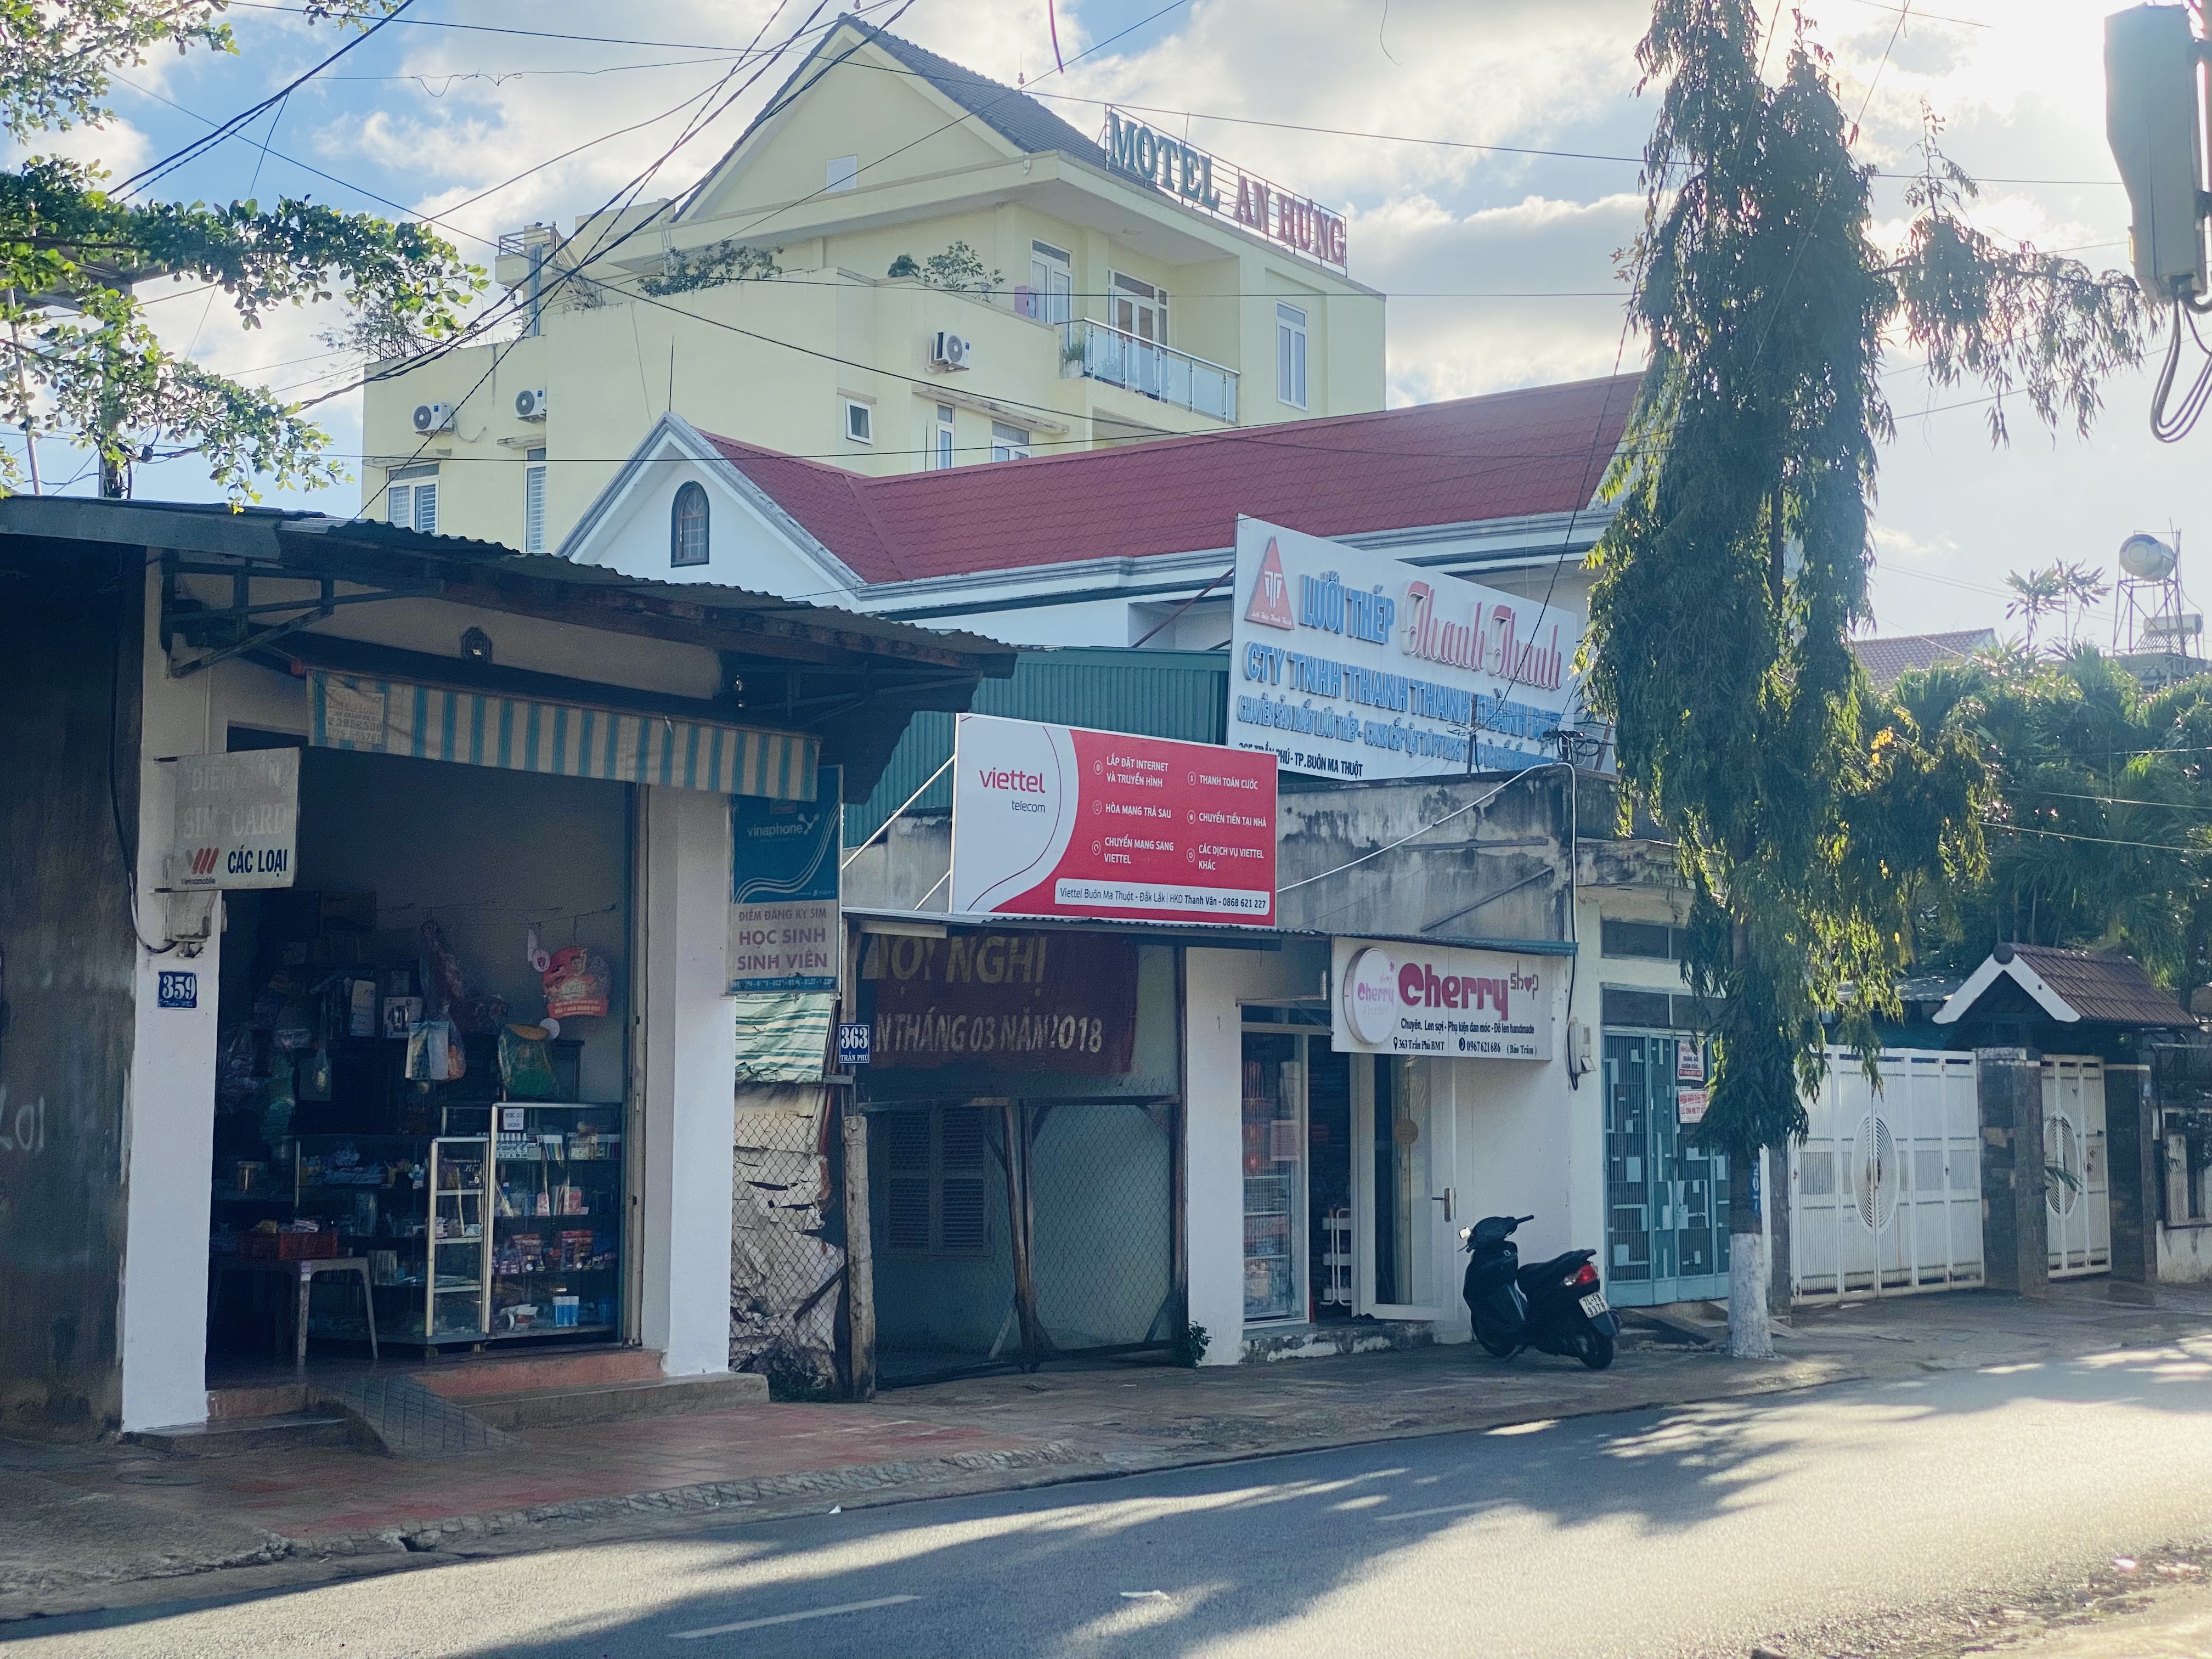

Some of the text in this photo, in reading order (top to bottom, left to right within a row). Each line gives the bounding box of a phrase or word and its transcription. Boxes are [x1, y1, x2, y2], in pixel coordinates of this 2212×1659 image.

[1107, 111, 1346, 267] MOTEL AN HƯNG
[1300, 571, 1345, 634] LƯỚI
[1345, 584, 1395, 645] THÉP
[1401, 579, 1485, 672] Thanh
[1243, 641, 1287, 685] CTY
[1287, 651, 1342, 698] TNHH
[1342, 664, 1409, 712] THANH
[1409, 680, 1472, 725] THANH
[1107, 753, 1169, 772] LẮP ĐẶT INTERNET
[1328, 759, 1339, 773] MA
[1341, 760, 1363, 779] THUỘT
[979, 767, 1045, 793] viettel
[1107, 770, 1116, 782] VÀ
[1146, 775, 1163, 787] HÌNH
[1199, 775, 1221, 786] THANH
[1222, 777, 1239, 788] TOÁN
[1012, 800, 1045, 812] telecom
[1122, 805, 1142, 816] MẠNG
[1158, 809, 1171, 818] SAU
[747, 822, 803, 838] vinaphone
[1242, 817, 1252, 827] TẠI
[1105, 834, 1174, 851] CHUYỂN MẠNG SANG
[1198, 843, 1264, 859] CÁC DỊCH VỤ VIETTEL
[227, 844, 288, 878] CÁC LOẠI
[1104, 853, 1131, 864] VIETTEL
[1199, 859, 1216, 870] KHÁC
[1060, 887, 1082, 898] Viettel
[1084, 889, 1101, 899] Buôn
[1103, 890, 1113, 900] Ma
[1115, 891, 1133, 902] Thuột
[1170, 894, 1183, 904] HKD
[1184, 895, 1204, 905] Thanh
[1205, 896, 1217, 906] Vân
[1223, 898, 1239, 907] 0868
[1240, 899, 1252, 907] 621
[1254, 900, 1266, 909] 227
[810, 907, 827, 918] SIM
[739, 927, 826, 949] HỌC SINH
[737, 950, 828, 971] SINH VIÊN
[162, 975, 196, 1000] 359
[1358, 983, 1393, 1006] Cherry
[1398, 962, 1508, 1021] Cherry
[894, 1006, 969, 1053] THÁNG
[970, 1015, 996, 1052] 03
[1424, 1019, 1434, 1031] Len
[1448, 1021, 1458, 1035] Phụ
[1510, 1024, 1534, 1034] handmade
[841, 1026, 868, 1049] 363
[1398, 1039, 1408, 1049] 363
[1431, 1041, 1445, 1051] BMT
[840, 1051, 868, 1061] TRẦN PHÚ
